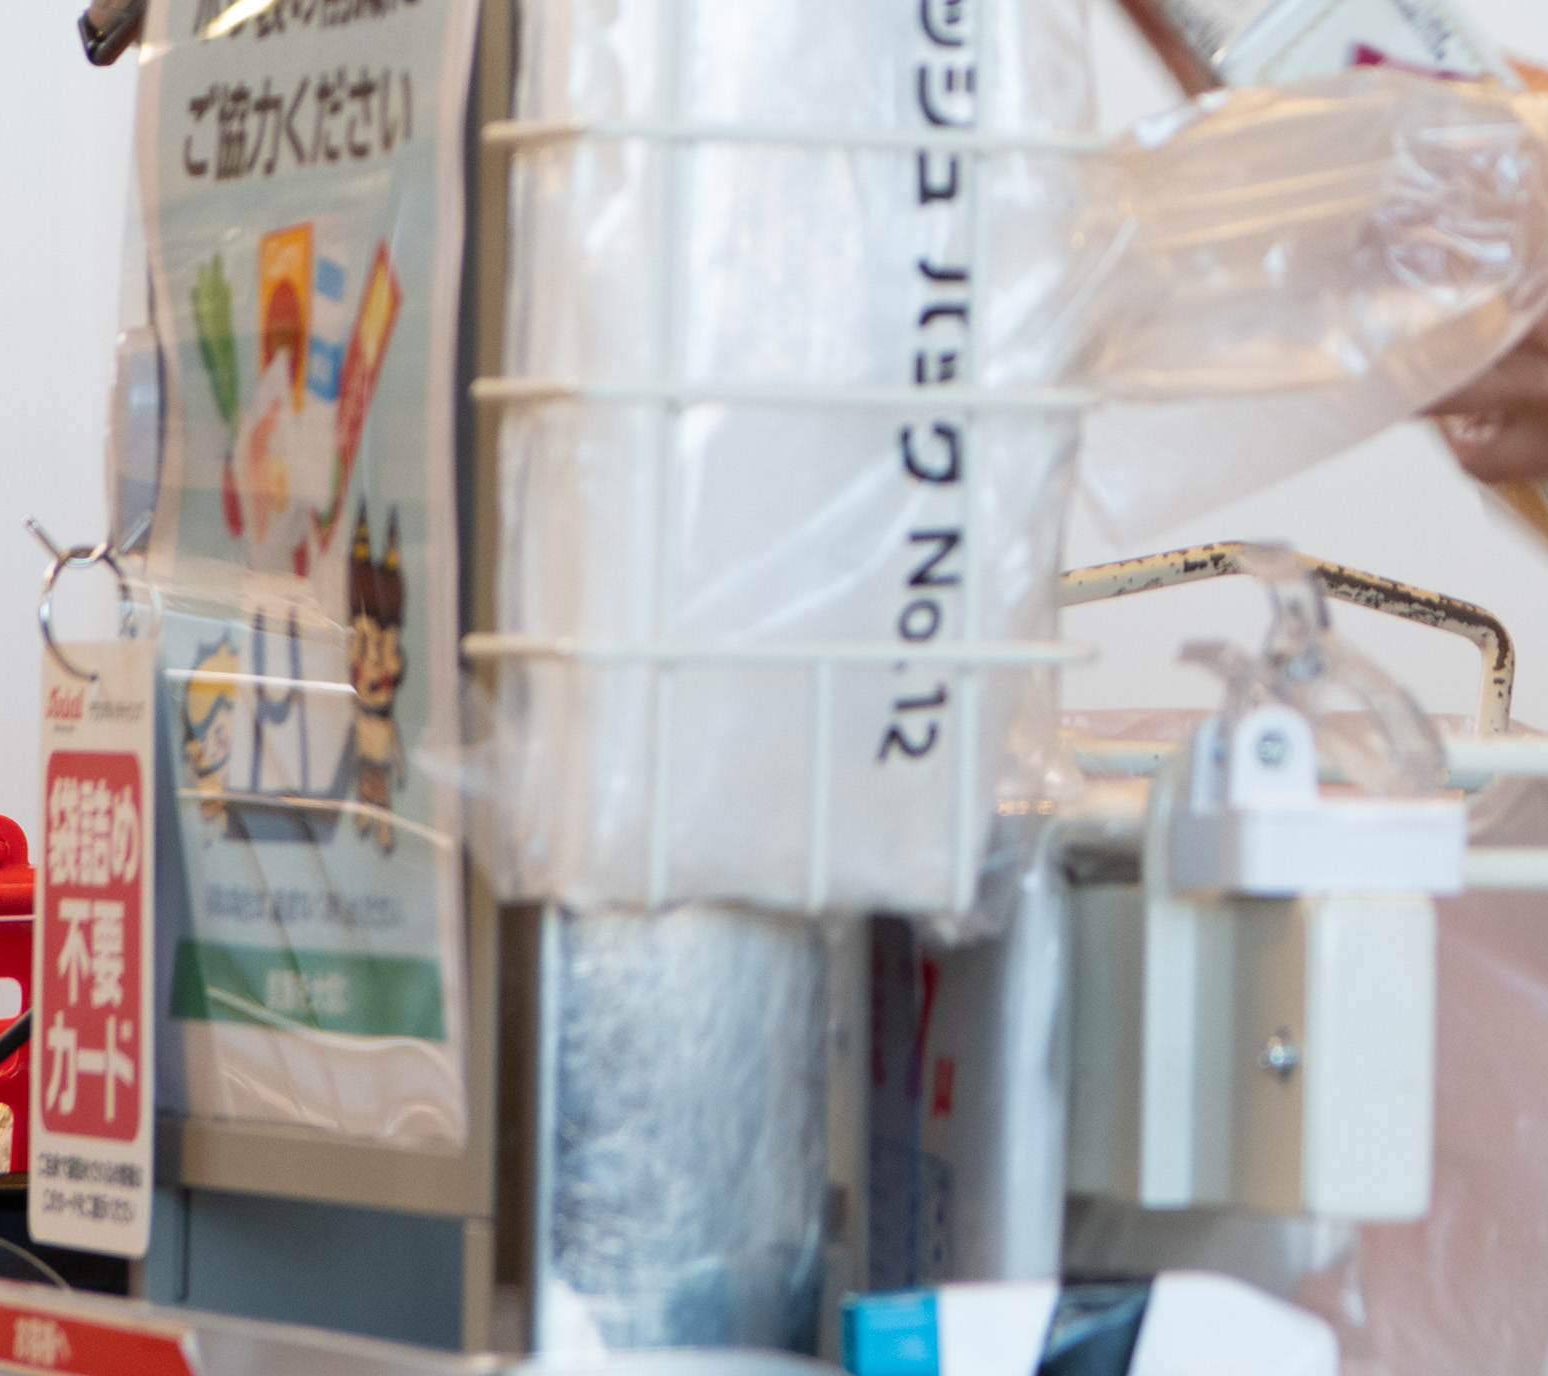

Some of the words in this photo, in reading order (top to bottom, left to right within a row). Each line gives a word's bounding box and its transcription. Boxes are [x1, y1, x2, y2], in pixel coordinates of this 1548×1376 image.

[182, 62, 414, 182] ご協力ください
[874, 527, 964, 767] No.12
[49, 776, 141, 887] 袋詰め
[56, 897, 127, 1009] 不要
[45, 1009, 136, 1124] カード
